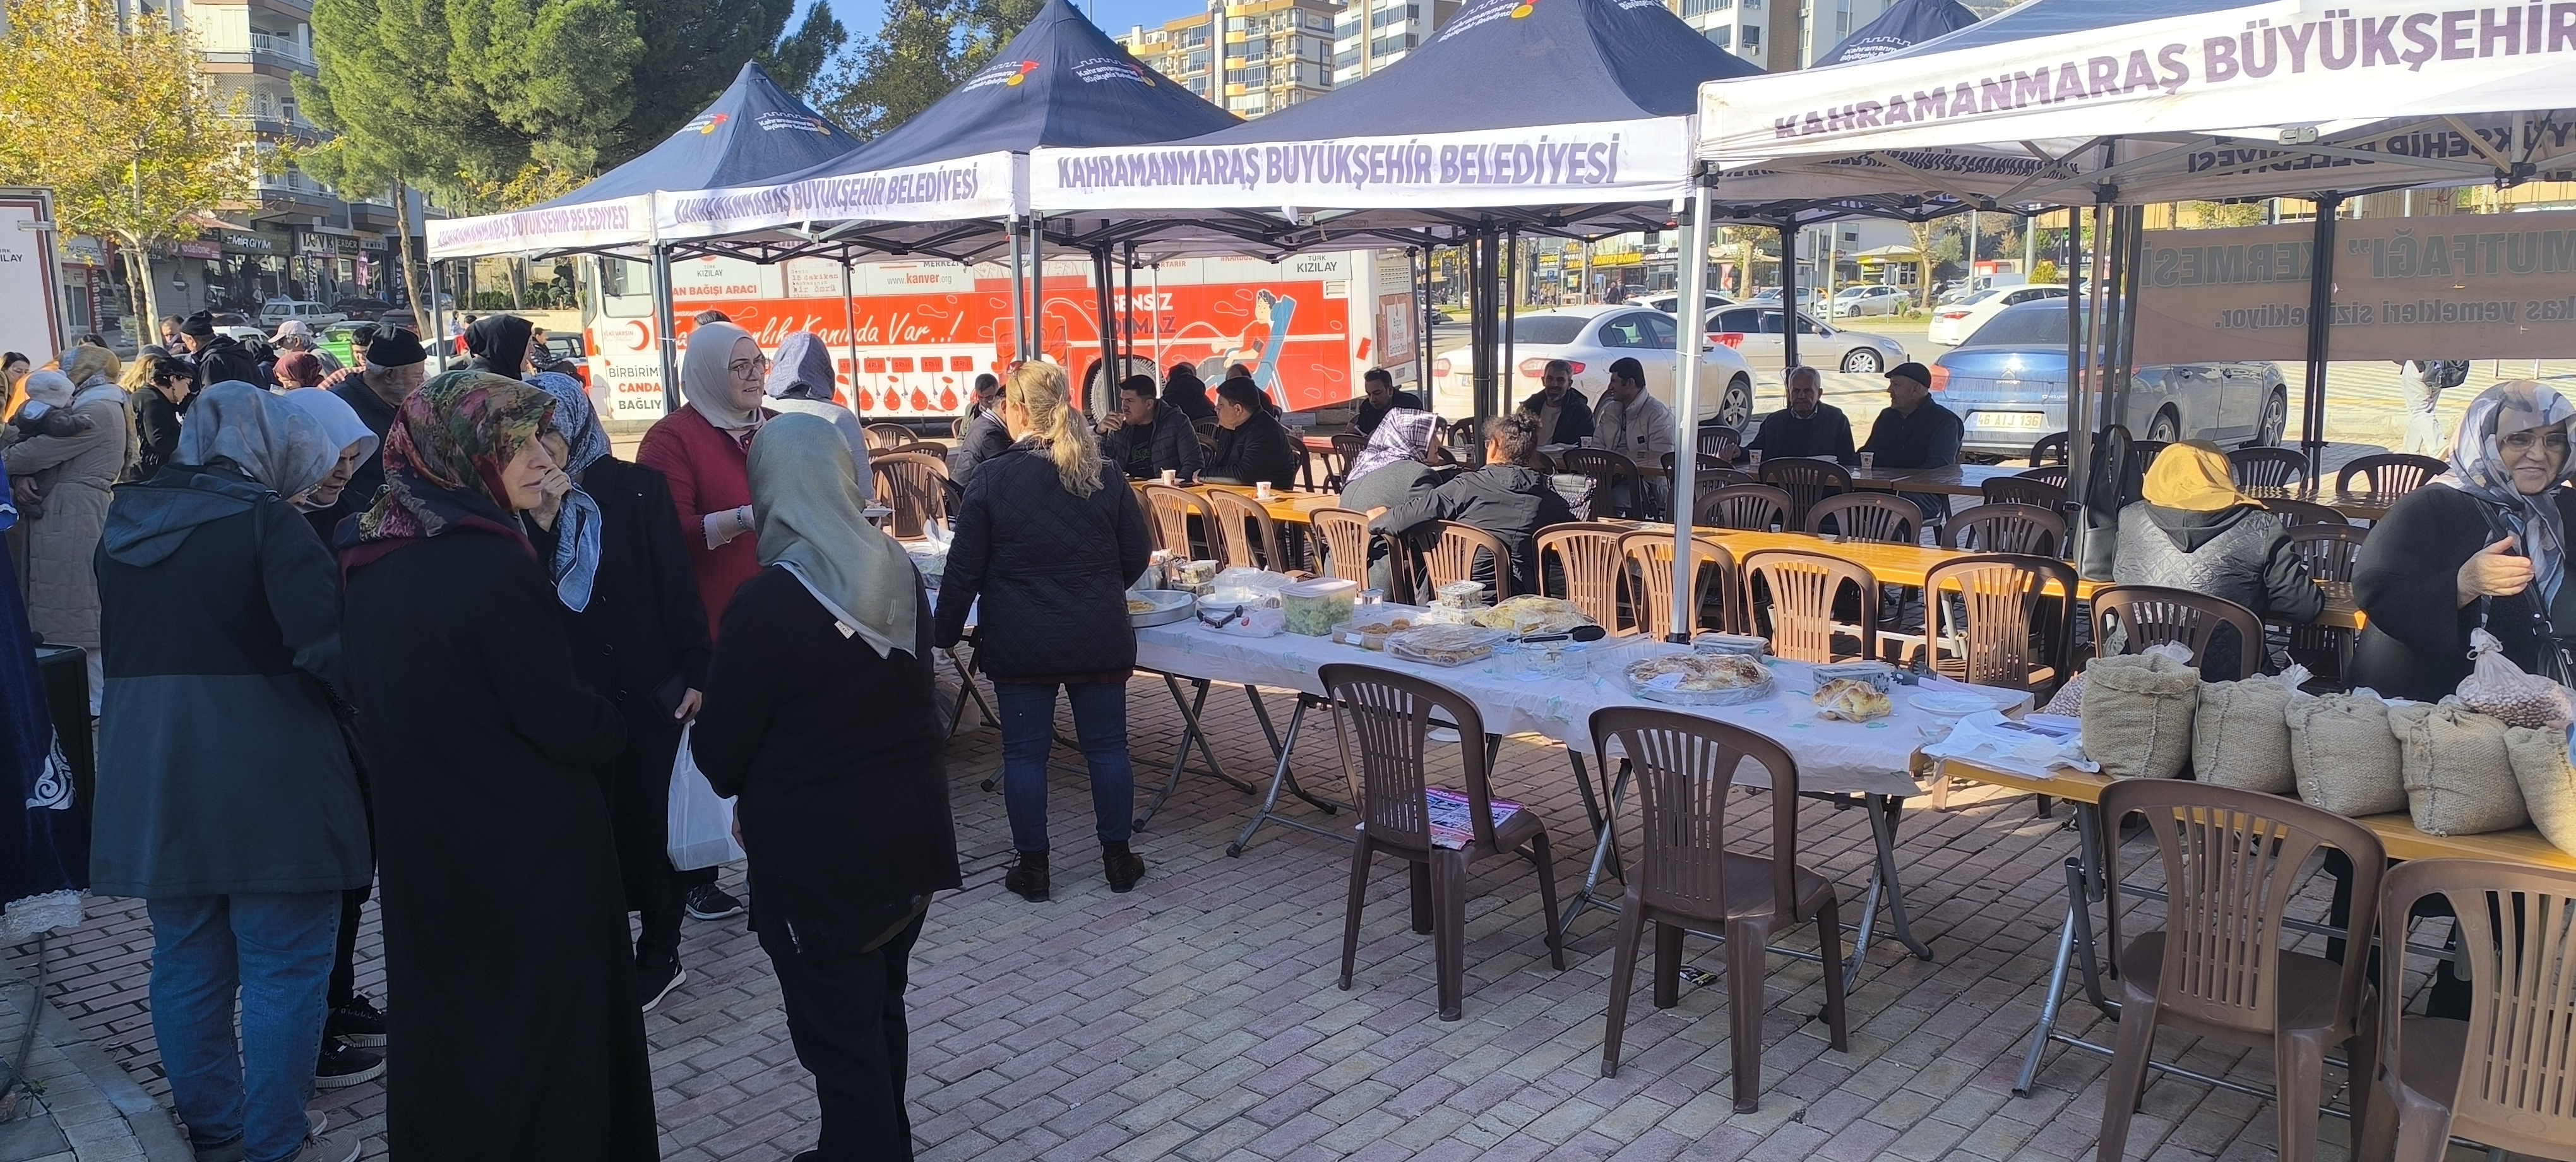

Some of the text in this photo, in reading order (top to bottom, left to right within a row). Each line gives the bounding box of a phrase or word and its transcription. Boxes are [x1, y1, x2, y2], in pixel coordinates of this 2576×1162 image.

[1775, 43, 2190, 140] KAHRAMANMARAŞ
[1058, 147, 1260, 191] KAHRAMANMARAŞ
[1440, 133, 1620, 184] BELEDİYESİ
[674, 185, 791, 224] KAHRAMANMARAŞ
[887, 162, 979, 205] BELEDİYESİ
[438, 217, 510, 249] KAHRAMANMARAŞ
[181, 241, 210, 255] vodafone
[1297, 261, 1337, 273] KIZILAY
[887, 273, 952, 285] www.kanver.org
[689, 284, 723, 296] BAĞIŞI
[725, 285, 757, 295] ARACI
[814, 285, 837, 293] ömrü
[1978, 414, 2039, 426] 46 AIJ 136
